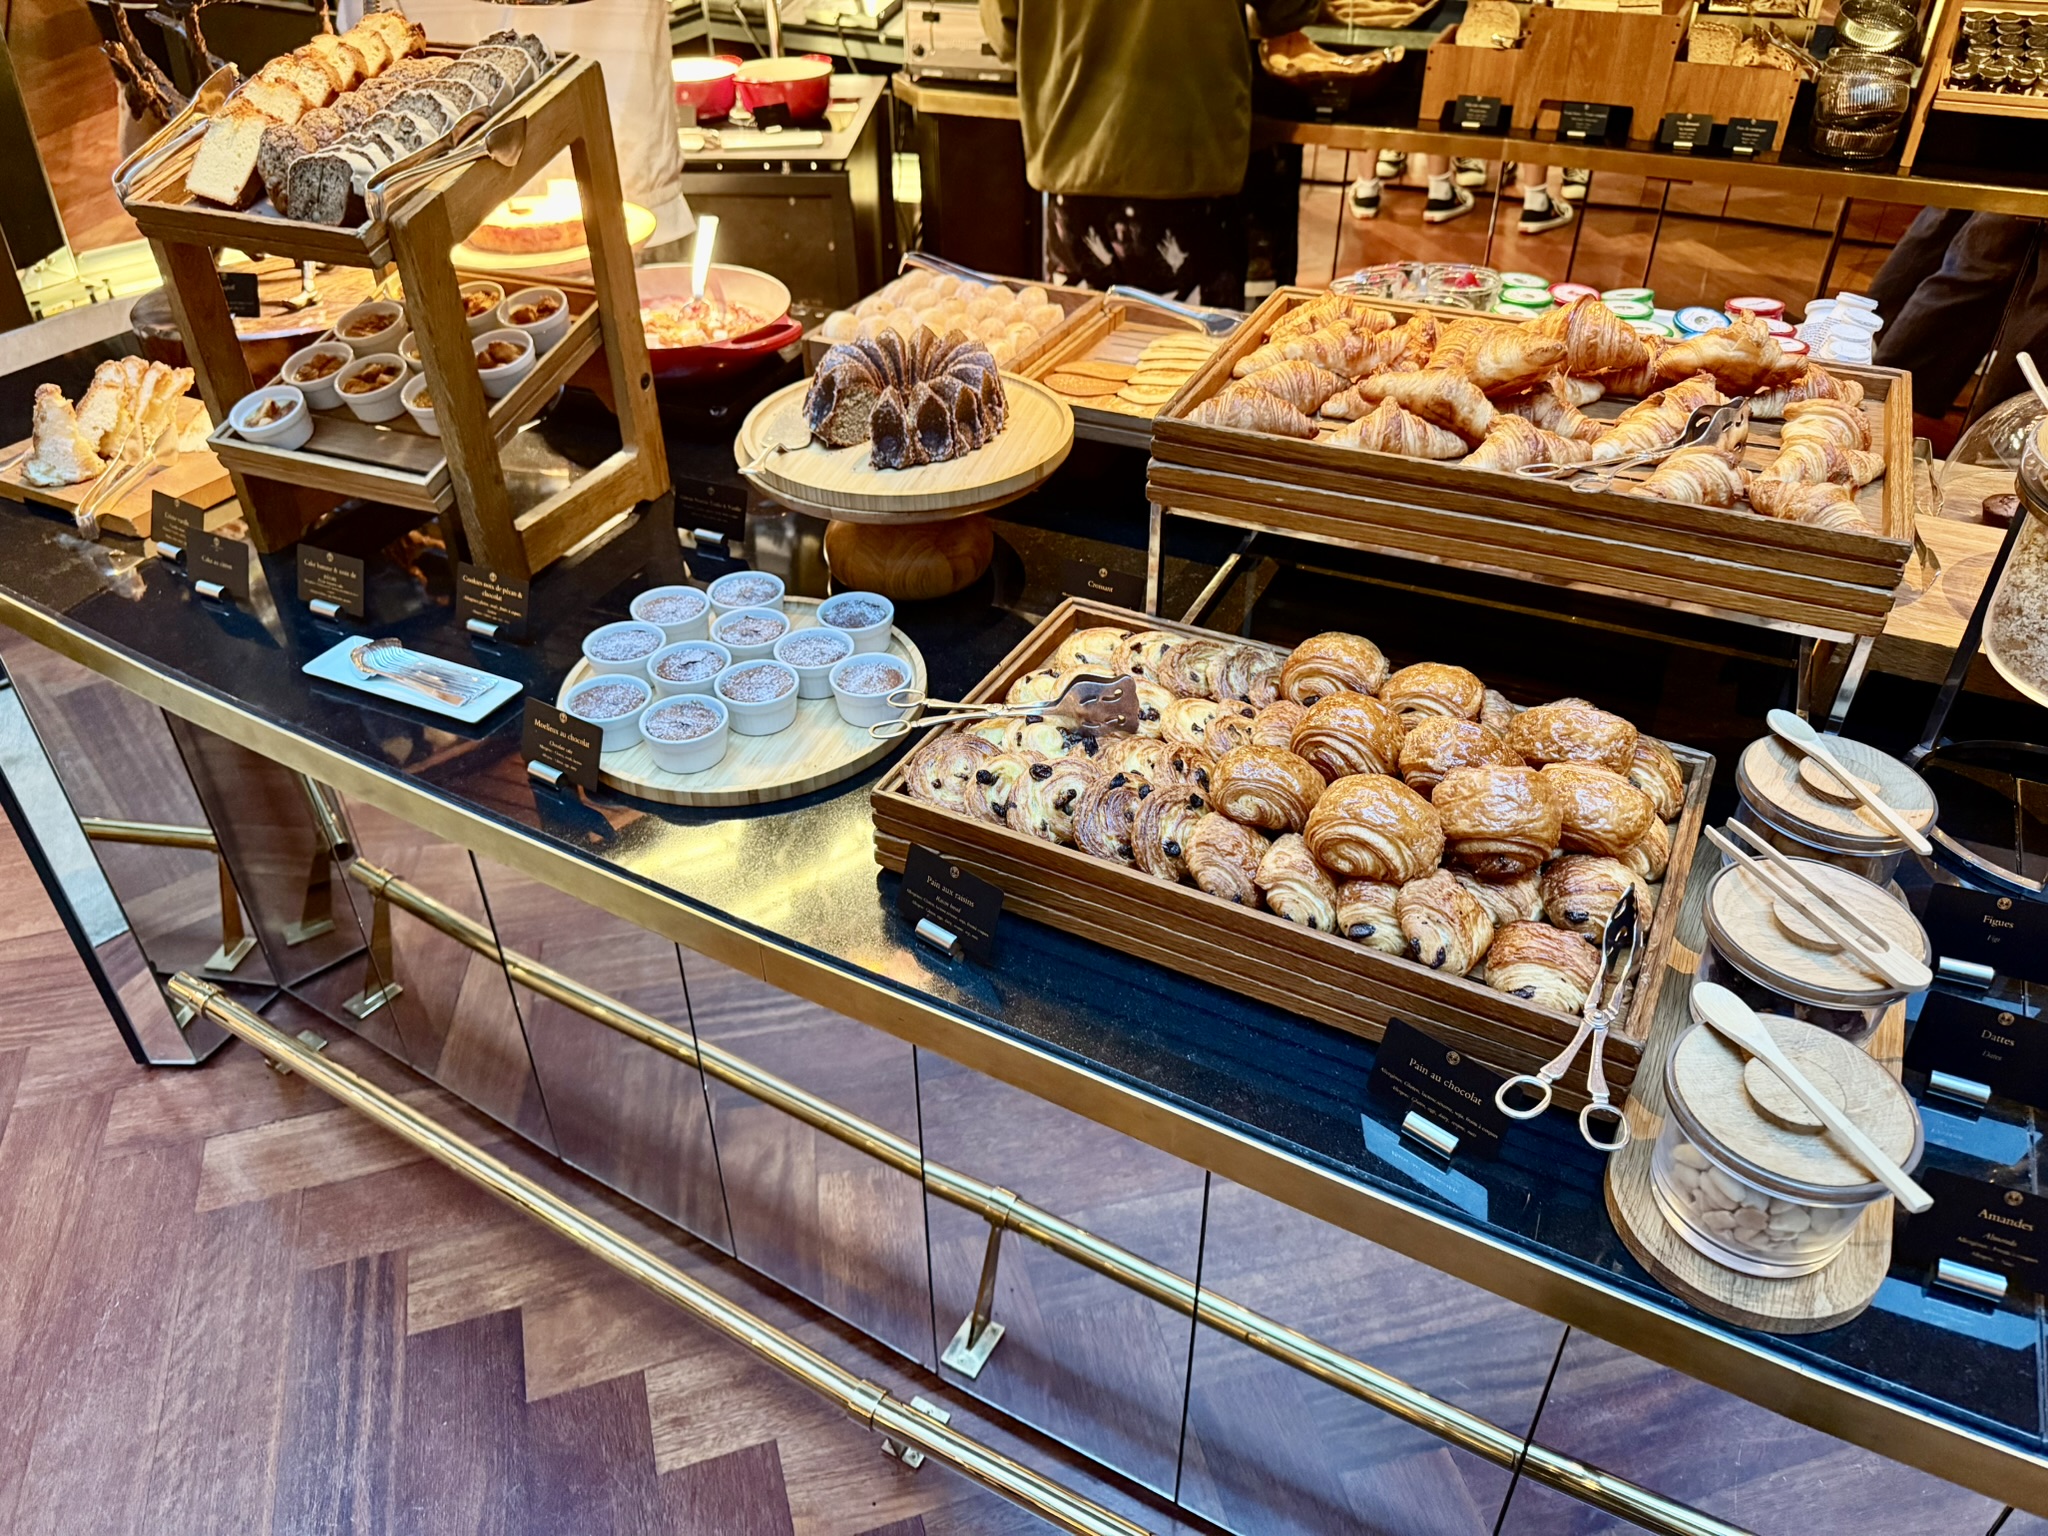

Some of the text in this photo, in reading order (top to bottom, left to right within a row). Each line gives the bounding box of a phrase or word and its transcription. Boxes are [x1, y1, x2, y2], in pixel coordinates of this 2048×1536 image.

[926, 875, 976, 908] Pain aux raisins
[1983, 914, 2015, 929] Figues
[1981, 1029, 2015, 1047] Dattes
[1408, 1057, 1483, 1106] Pain au chocolat
[1978, 1209, 2034, 1231] Amandes
